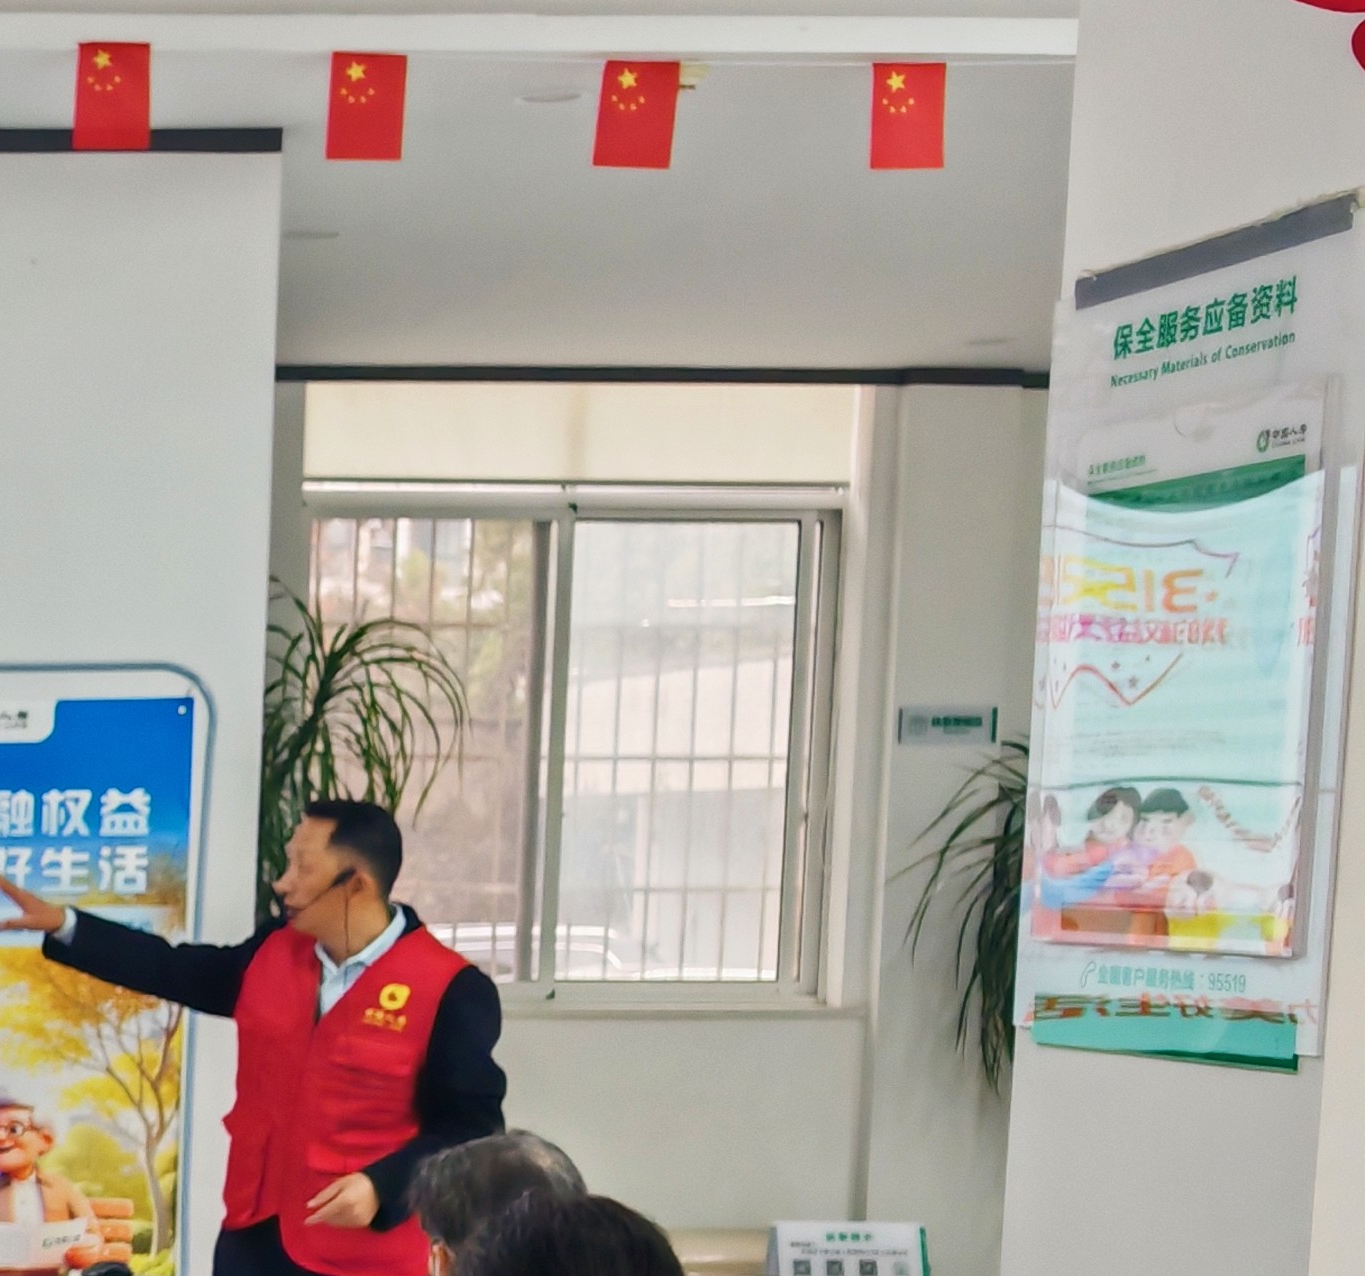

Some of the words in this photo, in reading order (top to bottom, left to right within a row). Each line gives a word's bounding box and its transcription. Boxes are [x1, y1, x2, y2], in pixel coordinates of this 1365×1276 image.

[1112, 275, 1299, 360] 保全服务应备资料
[1110, 366, 1158, 388] Necessary
[1161, 351, 1209, 375] Materials
[1211, 347, 1222, 364] of
[1225, 330, 1296, 360] Conservation
